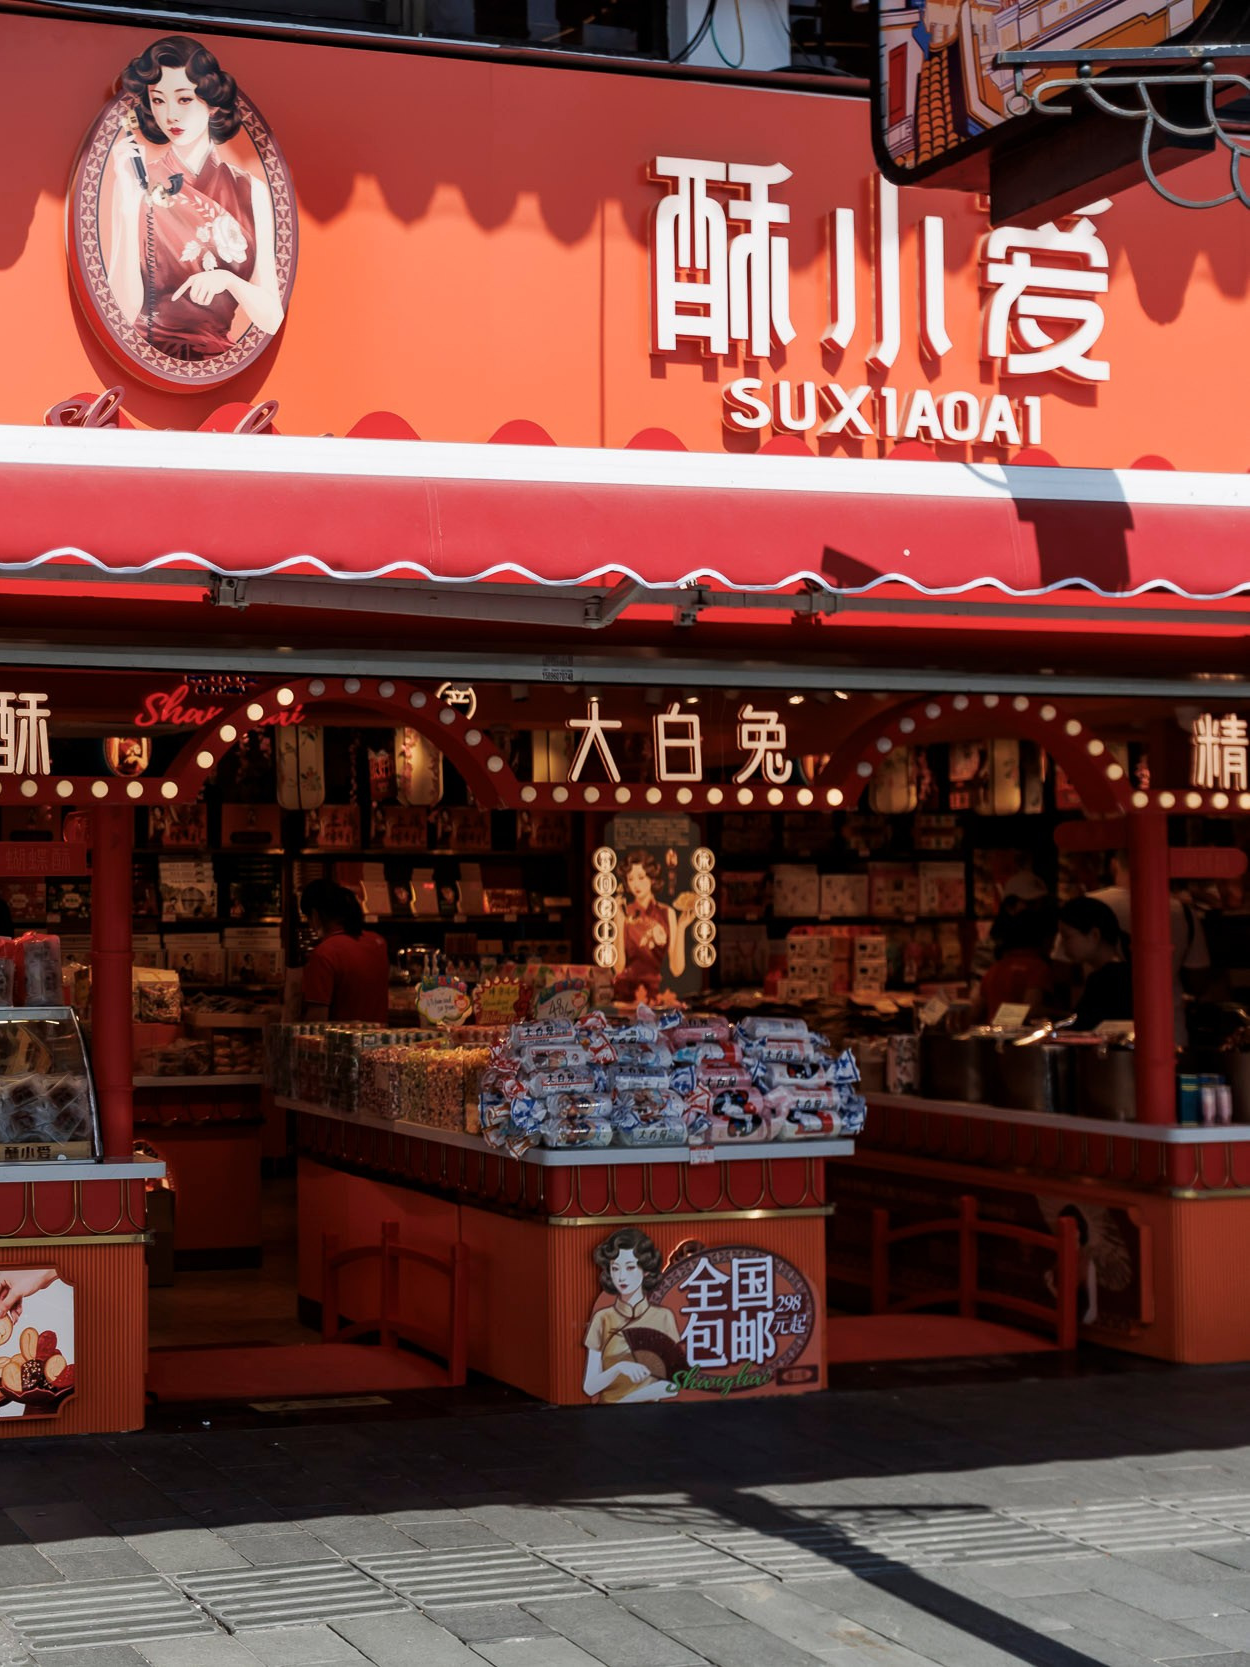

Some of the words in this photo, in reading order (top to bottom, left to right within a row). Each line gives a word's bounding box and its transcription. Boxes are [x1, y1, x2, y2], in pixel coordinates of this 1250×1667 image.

[652, 156, 1110, 381] 酥小爱
[728, 377, 1041, 445] SUXIAOAI
[566, 701, 793, 785] 大白兔
[1193, 712, 1249, 790] 精
[4, 1146, 51, 1160] 酥小爱
[679, 1255, 774, 1313] 全国
[774, 1294, 802, 1313] 298
[681, 1310, 776, 1368] 包邮
[773, 1313, 807, 1335] 元起
[665, 1361, 771, 1395] Shanghai
